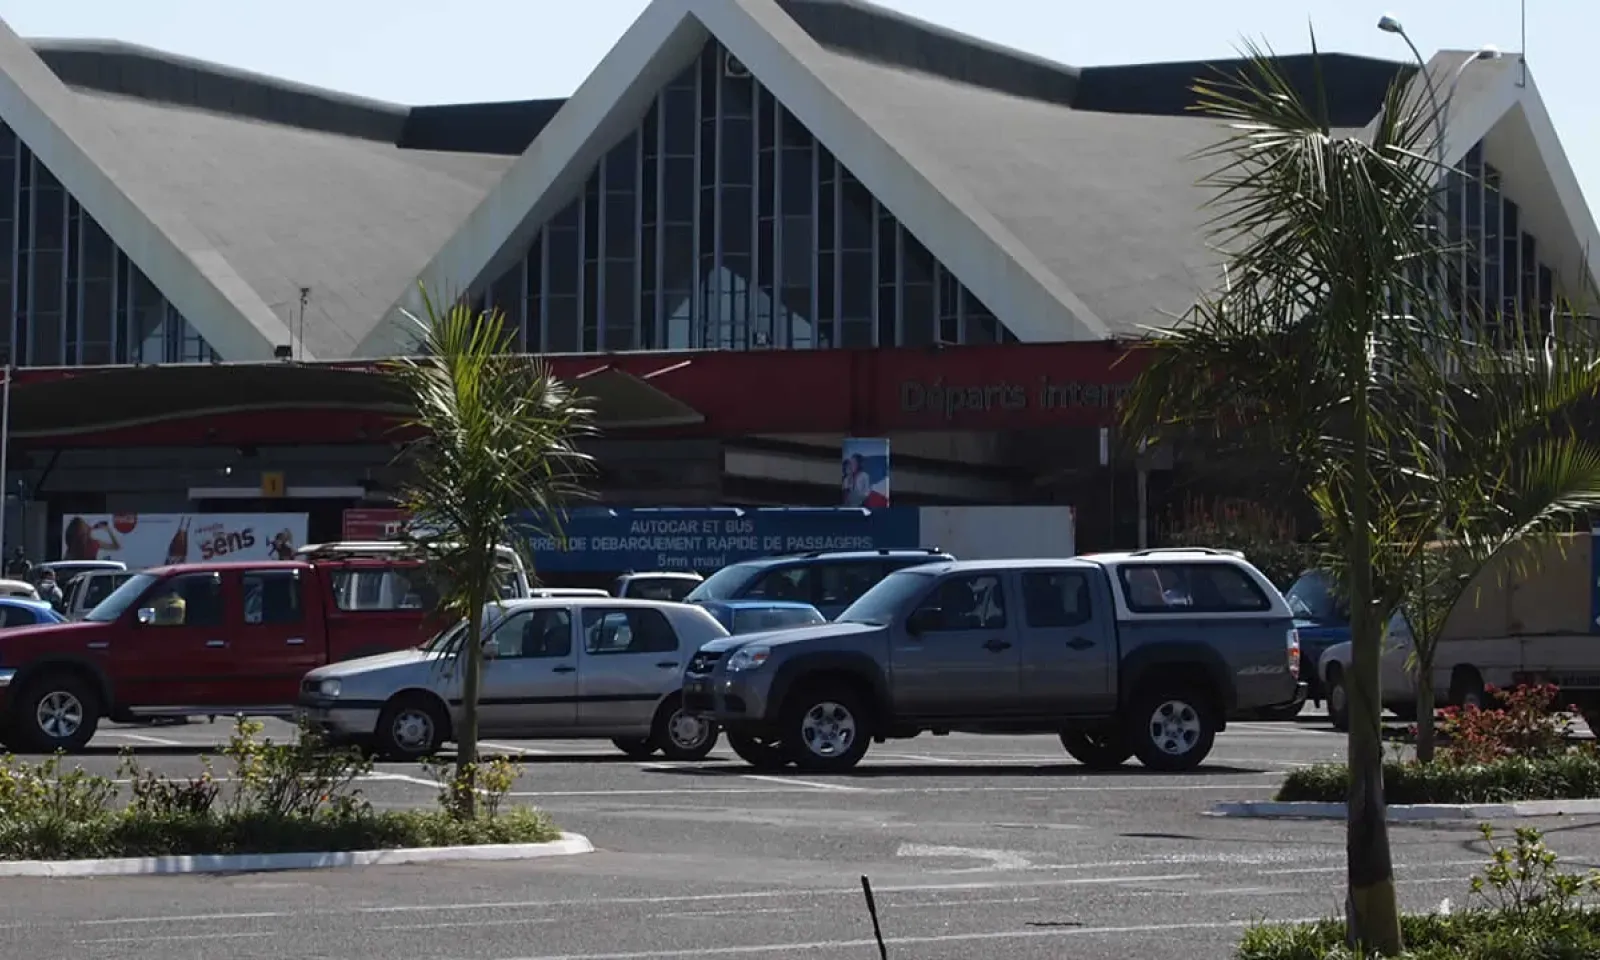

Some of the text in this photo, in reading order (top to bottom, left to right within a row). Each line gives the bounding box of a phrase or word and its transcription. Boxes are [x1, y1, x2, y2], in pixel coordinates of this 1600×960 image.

[900, 376, 1026, 420] Départs
[630, 519, 753, 533] AUTOCAR ET BUS
[528, 536, 873, 551] RRET DE DEBARQUEMENT RAPIDE DE PASSAGERS
[657, 554, 726, 567] 5mn maxi
